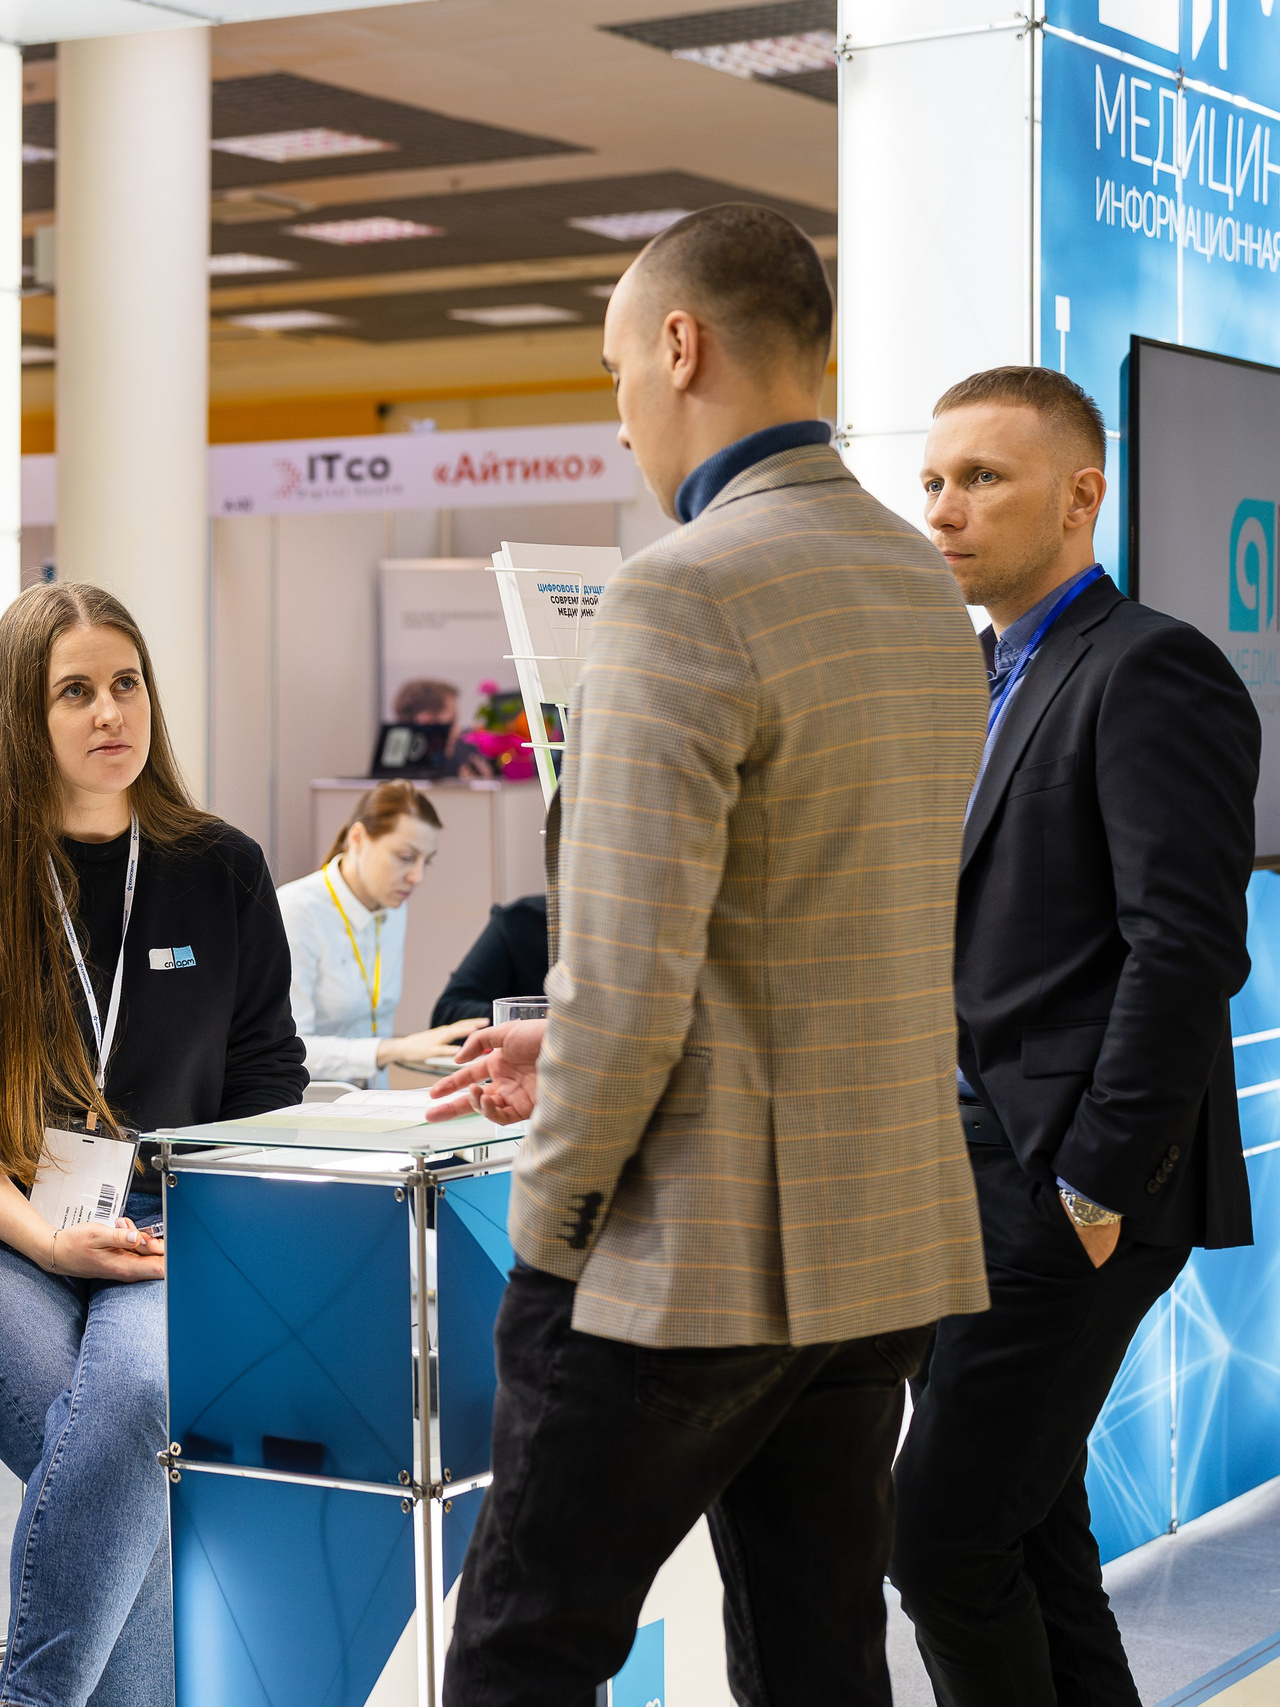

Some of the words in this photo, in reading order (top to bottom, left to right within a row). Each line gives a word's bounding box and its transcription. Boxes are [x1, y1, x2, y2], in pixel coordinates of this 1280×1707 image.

[307, 453, 391, 483] ITco
[537, 583, 574, 594] ЦИФРОВОЕ
[575, 585, 605, 595] БДУЩЕ
[550, 595, 599, 606] СОВРЕМННОЙ
[558, 607, 596, 618] МЕДИИНЫ
